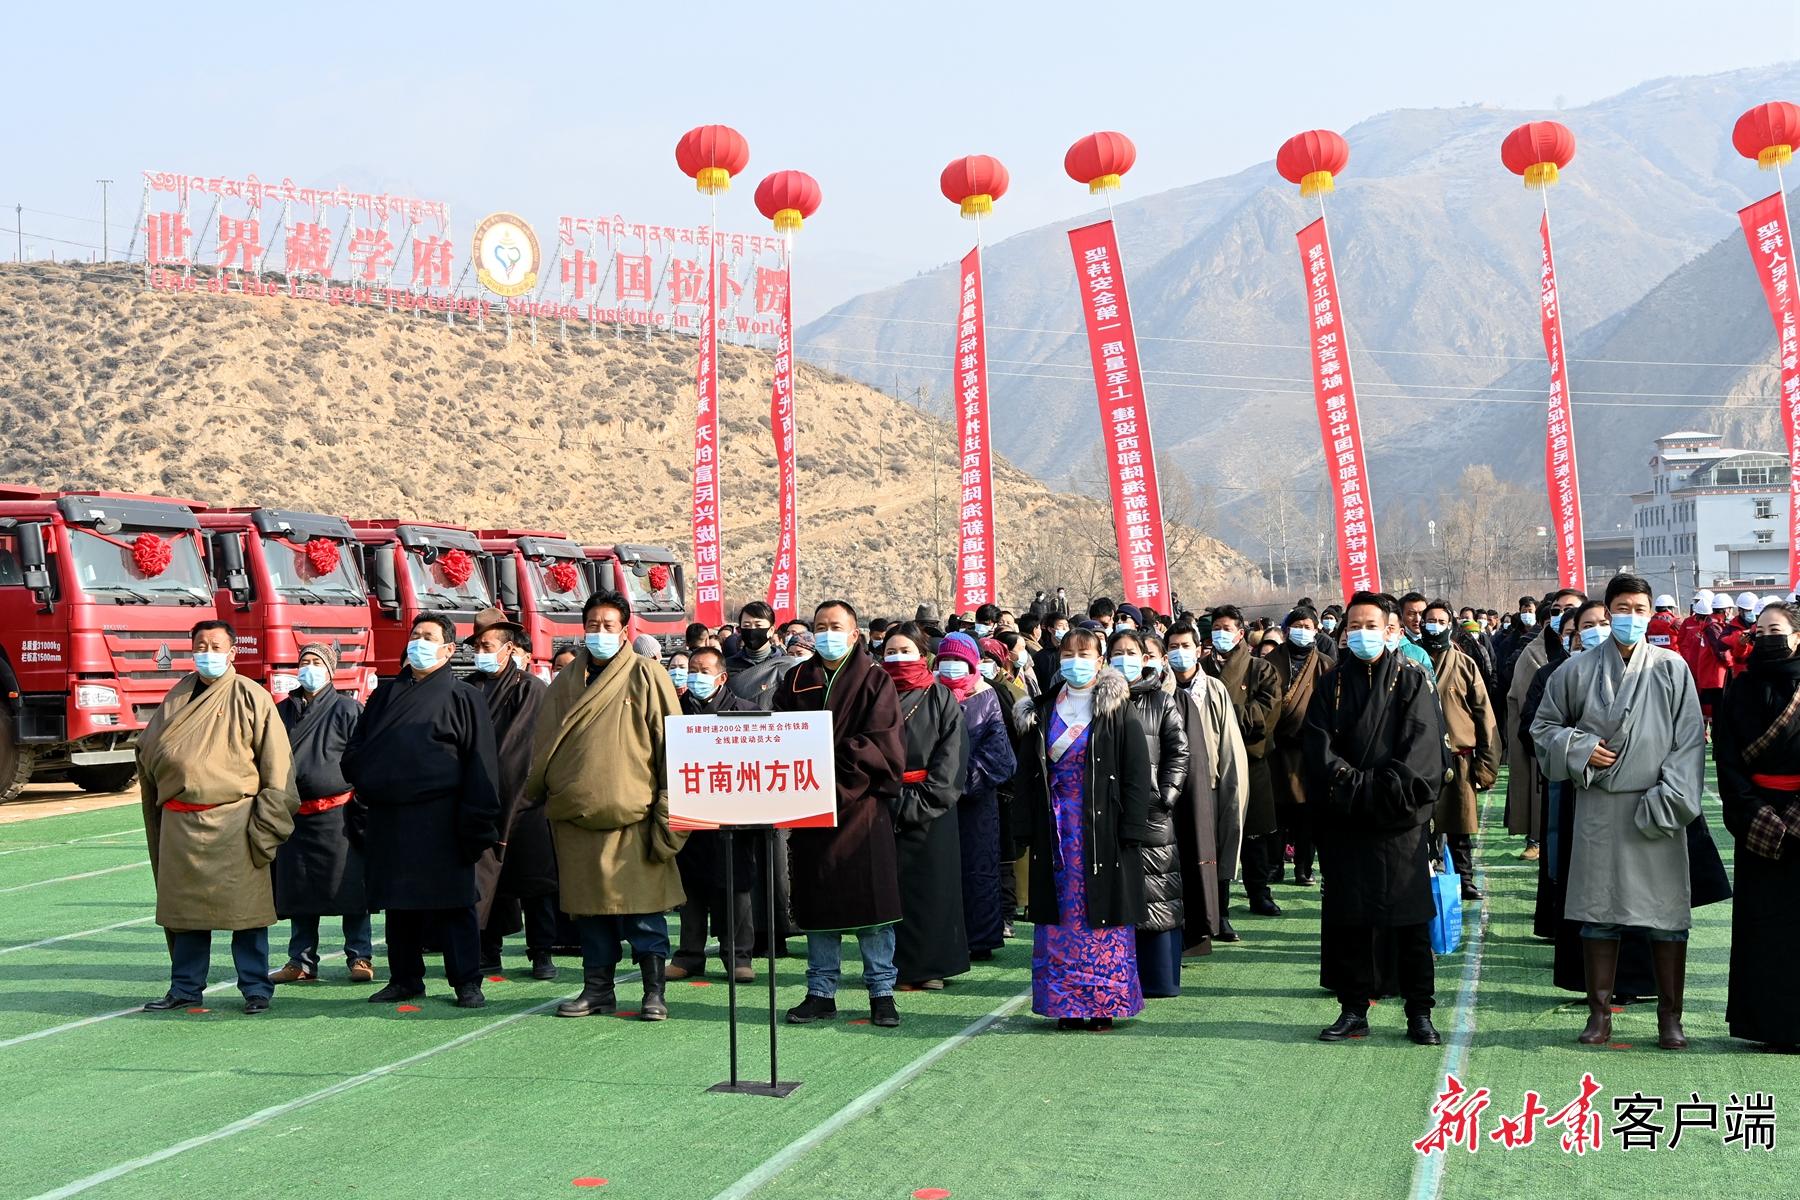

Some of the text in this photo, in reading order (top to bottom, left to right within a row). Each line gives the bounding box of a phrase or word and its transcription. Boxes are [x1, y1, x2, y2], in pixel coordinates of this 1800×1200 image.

[144, 211, 455, 288] 世界藏学府
[560, 249, 788, 314] 中国拉卜楞
[207, 272, 234, 294] of
[242, 277, 279, 297] the
[674, 311, 689, 328] in
[22, 640, 61, 652] 总质量31000kg
[686, 721, 809, 734] 新建时速200公里兰州至合作铁路
[715, 735, 781, 745] 全线建设动员大会
[679, 758, 820, 794] 甘南州方队
